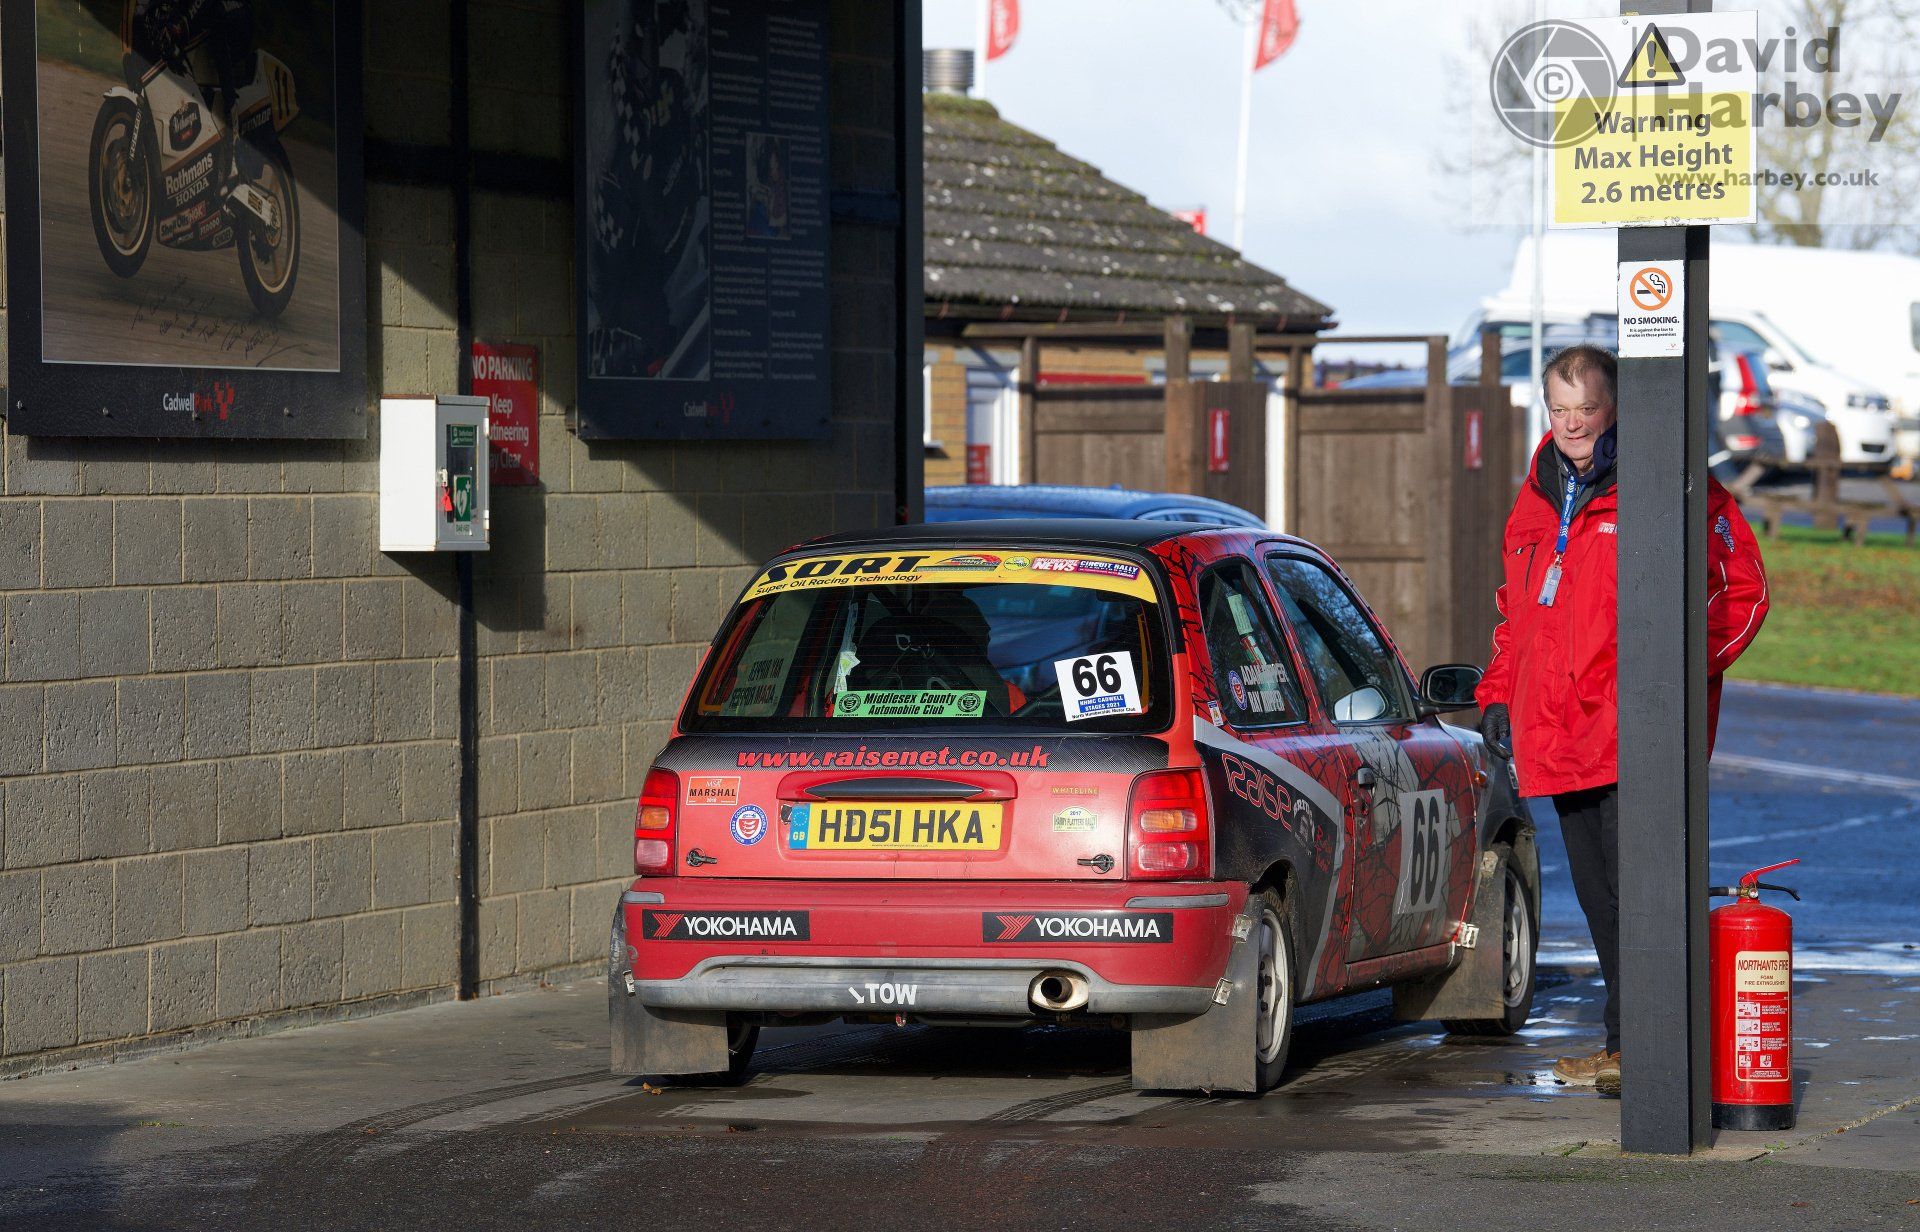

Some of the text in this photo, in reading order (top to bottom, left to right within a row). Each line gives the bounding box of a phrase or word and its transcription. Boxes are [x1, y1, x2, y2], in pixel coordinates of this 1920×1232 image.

[1594, 109, 1711, 136] Warning
[1575, 142, 1732, 172] Max Height
[165, 152, 214, 196] Rothmans
[175, 180, 210, 208] HONDA
[1581, 179, 1725, 203] 2.6 metres
[1624, 316, 1680, 325] NO SMOKING.
[488, 355, 533, 382] PARKING
[492, 393, 513, 419] Keep
[501, 447, 521, 469] Clear
[757, 555, 931, 588] SORT
[1032, 560, 1078, 572] NEWS
[1080, 560, 1111, 569] CIRCUIT
[1113, 563, 1139, 574] RALLY
[755, 573, 923, 596] Super Oil Racing Technology
[1072, 655, 1121, 698] 66
[863, 693, 957, 706] Middlesex County
[1085, 703, 1106, 712] STAGES
[1097, 694, 1124, 703] CADWELL
[868, 704, 920, 716] Automobile
[923, 704, 945, 715] Club
[736, 746, 1052, 768] www.raisenet.co.uk
[689, 788, 737, 797] MARSHAL
[1052, 787, 1098, 795] WHITELINE
[793, 832, 805, 840] GB
[818, 809, 984, 844] HD51 HKA
[1411, 795, 1441, 907] 66
[683, 916, 798, 936] YOKOHAMA
[1035, 916, 1162, 938] YOKOHAMA
[1738, 960, 1789, 971] NORTHANTS FIRE
[864, 984, 918, 1006] TOW
